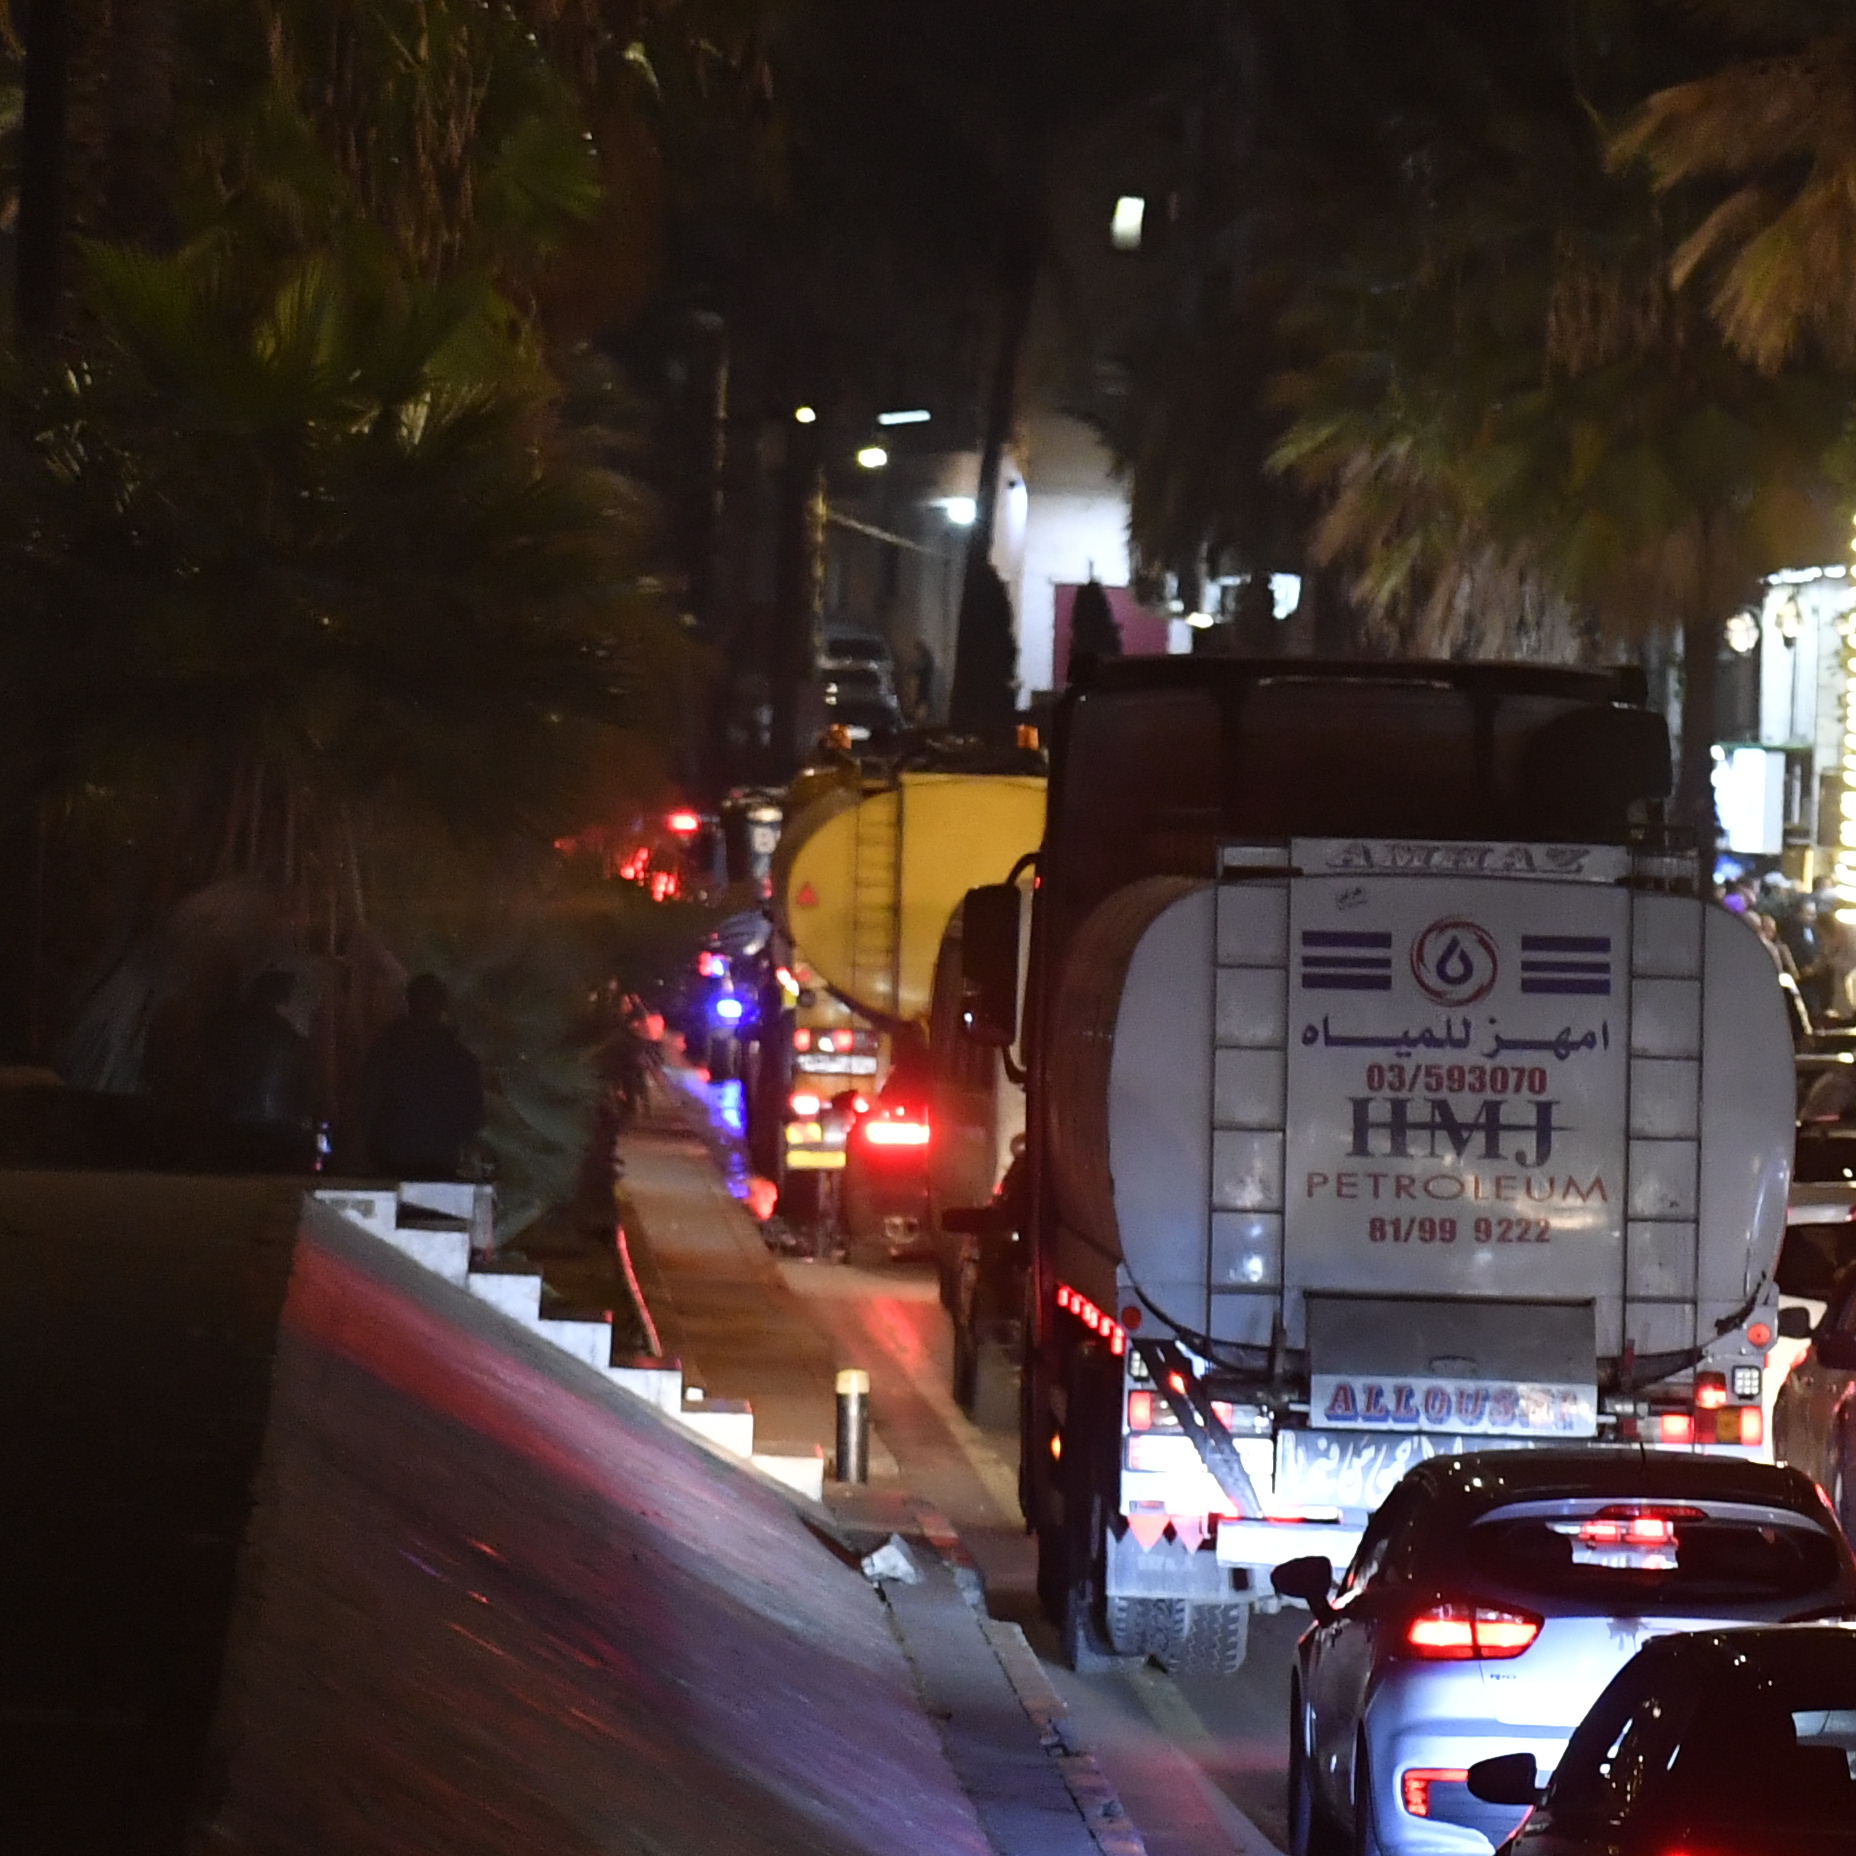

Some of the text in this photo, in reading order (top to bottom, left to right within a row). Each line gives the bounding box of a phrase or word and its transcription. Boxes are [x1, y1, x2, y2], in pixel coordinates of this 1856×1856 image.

[1301, 1013, 1472, 1058] للمياه
[1366, 1063, 1547, 1095] 03/593070
[1346, 1097, 1562, 1168] HMJ
[1306, 1172, 1608, 1204] PETROLEUM
[1369, 1217, 1551, 1243] 81/99 9222
